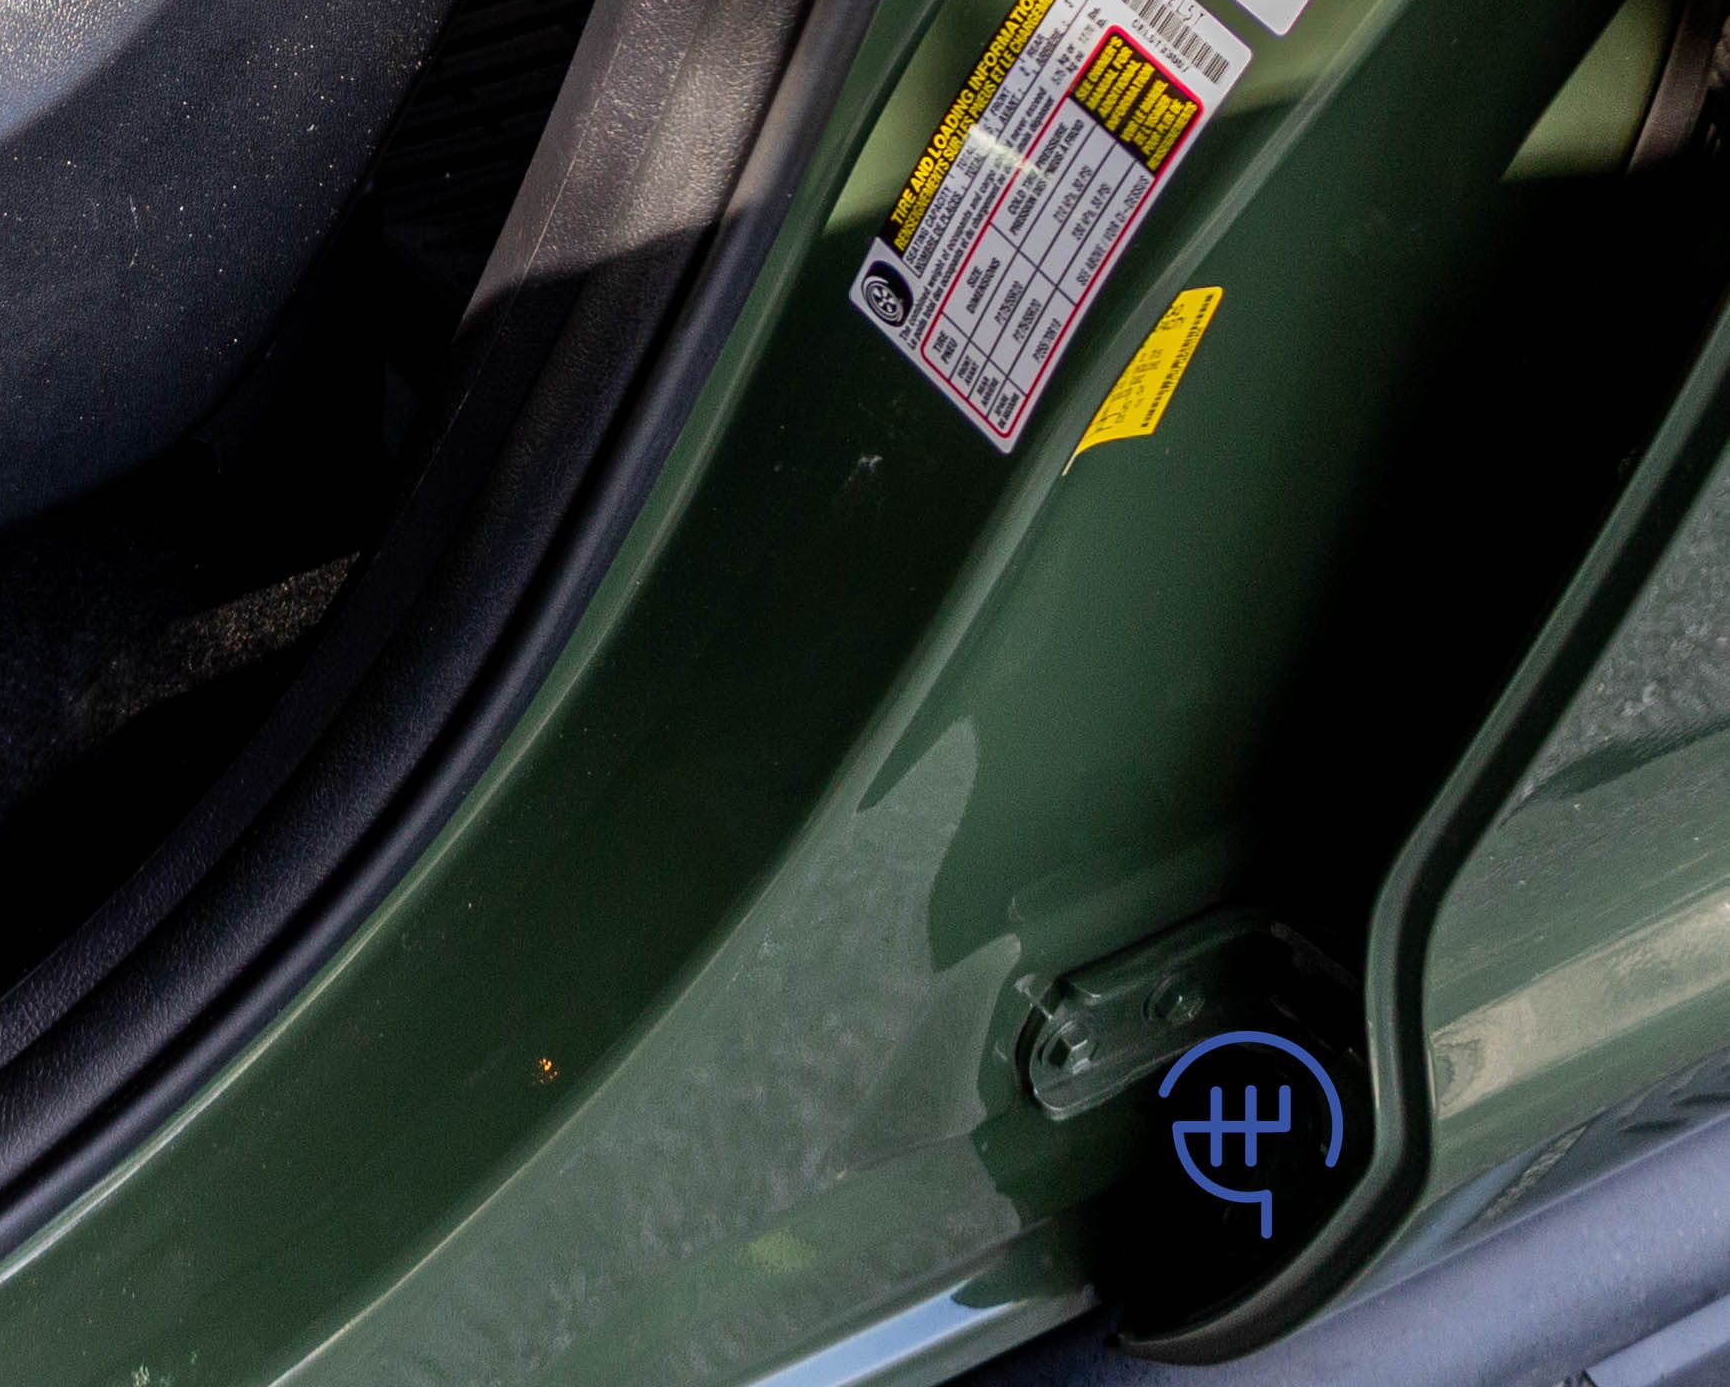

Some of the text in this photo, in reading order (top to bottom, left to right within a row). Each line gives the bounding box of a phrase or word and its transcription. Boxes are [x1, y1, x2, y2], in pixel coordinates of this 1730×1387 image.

[988, 62, 1007, 85] ET
[997, 47, 1016, 70] LE
[1073, 31, 1125, 104] SEE OWNER'S
[1084, 42, 1134, 113] MANUAL FOR
[967, 77, 998, 121] PNEUS
[1096, 53, 1142, 122] ADDITIONAL
[1103, 57, 1156, 136] INFORMATION
[941, 133, 963, 163] SUR
[954, 113, 975, 141] LES
[1145, 96, 1199, 175] RENSEIGNEMENTS
[888, 186, 918, 228] TIRE
[907, 153, 937, 194] AND
[926, 85, 976, 161] LOADING
[902, 224, 931, 266] SEATING
[922, 182, 955, 230] CAPACITY
[987, 84, 1012, 118] FRONT
[1005, 186, 1028, 217] COLD
[1033, 119, 1069, 172] PRESSURE
[1008, 192, 1039, 237] PRESSION
[1062, 116, 1086, 148] FROID
[890, 155, 954, 253] RENSEIGNEMENTS
[904, 284, 934, 328] combined
[924, 257, 947, 290] weight
[977, 167, 998, 197] cargo
[1008, 114, 1029, 143] never
[1022, 83, 1048, 119] exceed
[962, 254, 1004, 316] DIMENSIONS
[964, 264, 984, 290] SIZE
[1074, 265, 1092, 288] SEE
[1083, 241, 1107, 273] ABOVE
[930, 328, 950, 356] TIRE
[938, 336, 961, 367] PNEU
[954, 353, 974, 380] FRONT
[961, 359, 981, 388] AVANT
[974, 373, 991, 397] REAR
[991, 391, 1011, 418] SPARE
